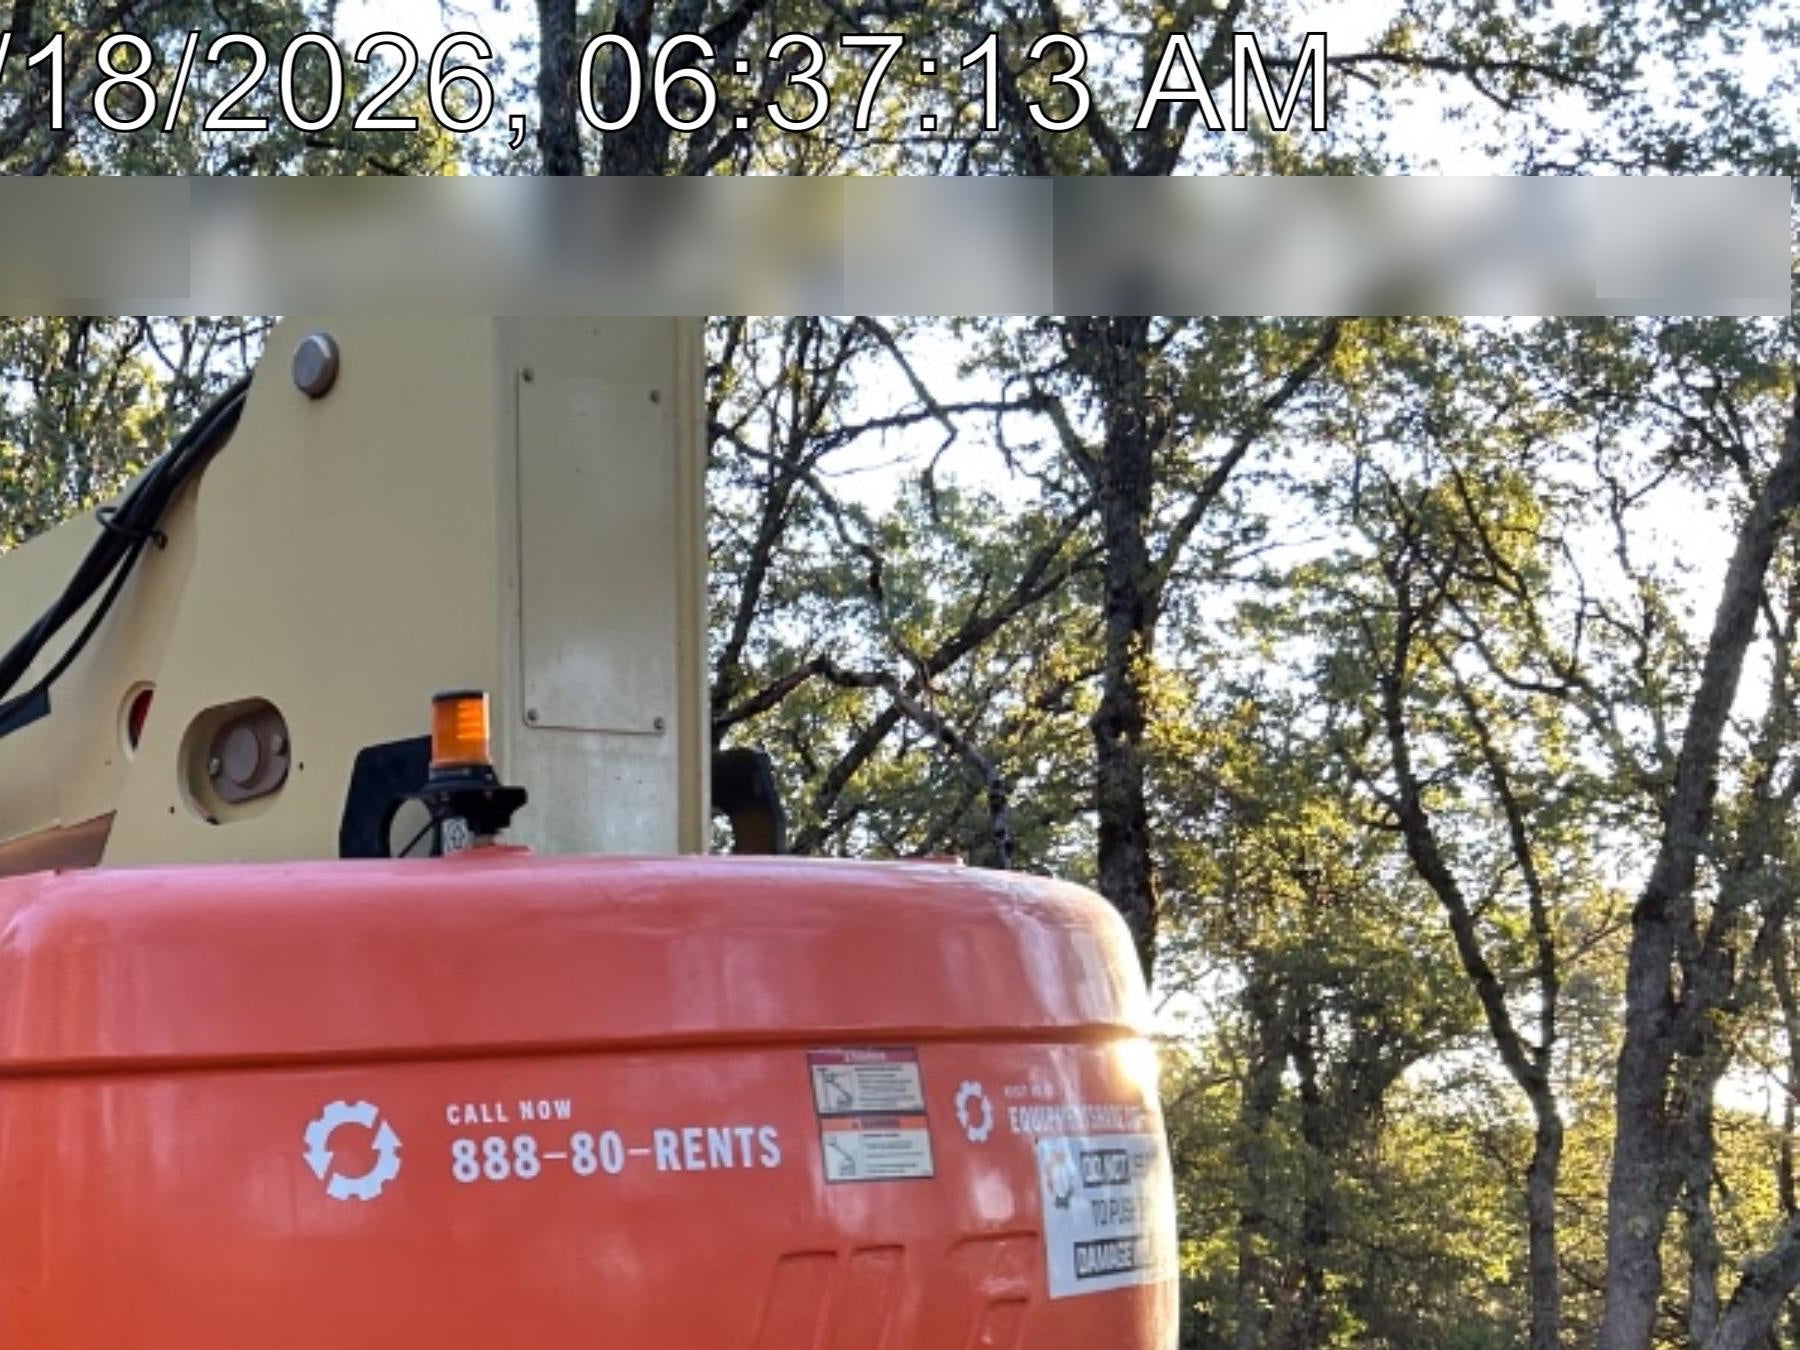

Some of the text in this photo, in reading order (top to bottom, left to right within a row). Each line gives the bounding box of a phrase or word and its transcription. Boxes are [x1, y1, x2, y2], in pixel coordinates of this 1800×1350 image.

[446, 1098, 572, 1125] CALL NOW
[451, 1125, 782, 1184] 888-80-RENTS
